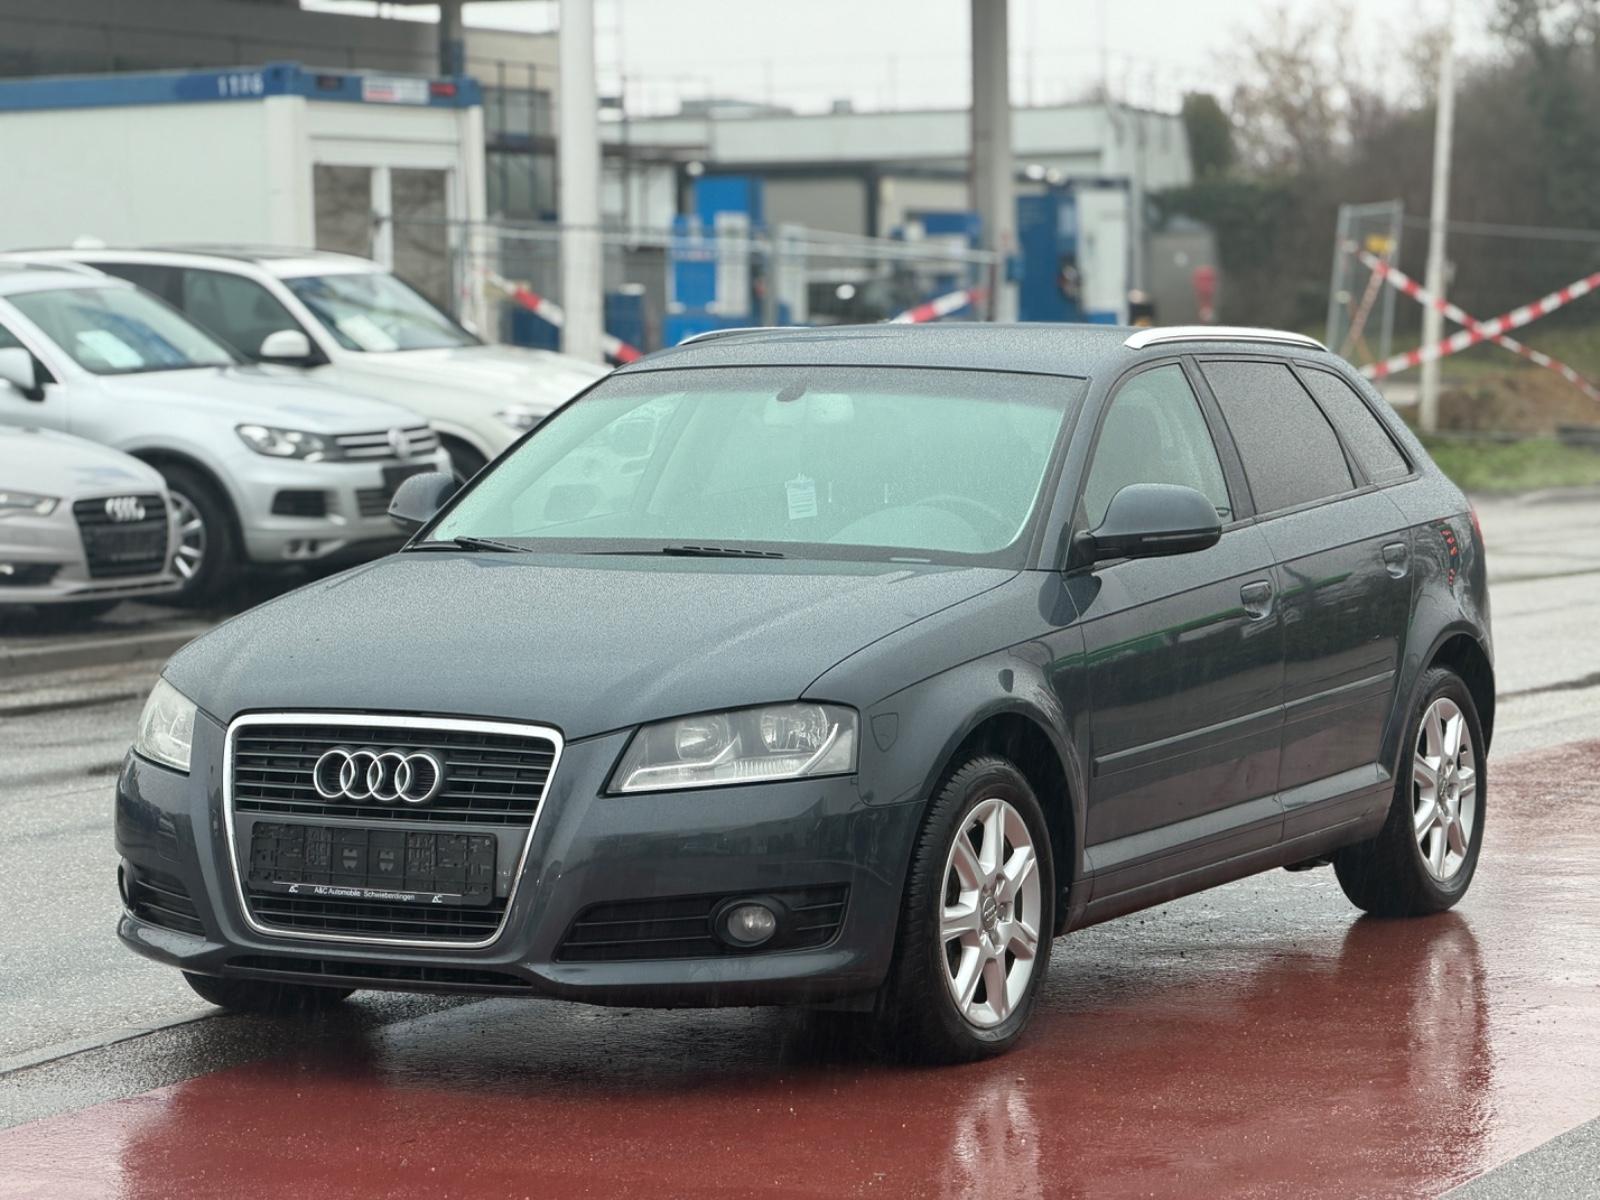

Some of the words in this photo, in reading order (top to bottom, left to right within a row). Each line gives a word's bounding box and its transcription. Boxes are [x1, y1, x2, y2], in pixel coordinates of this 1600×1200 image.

[314, 886, 327, 895] A&C
[328, 887, 361, 897] Automobile
[363, 889, 415, 901] Schwieberdingen
